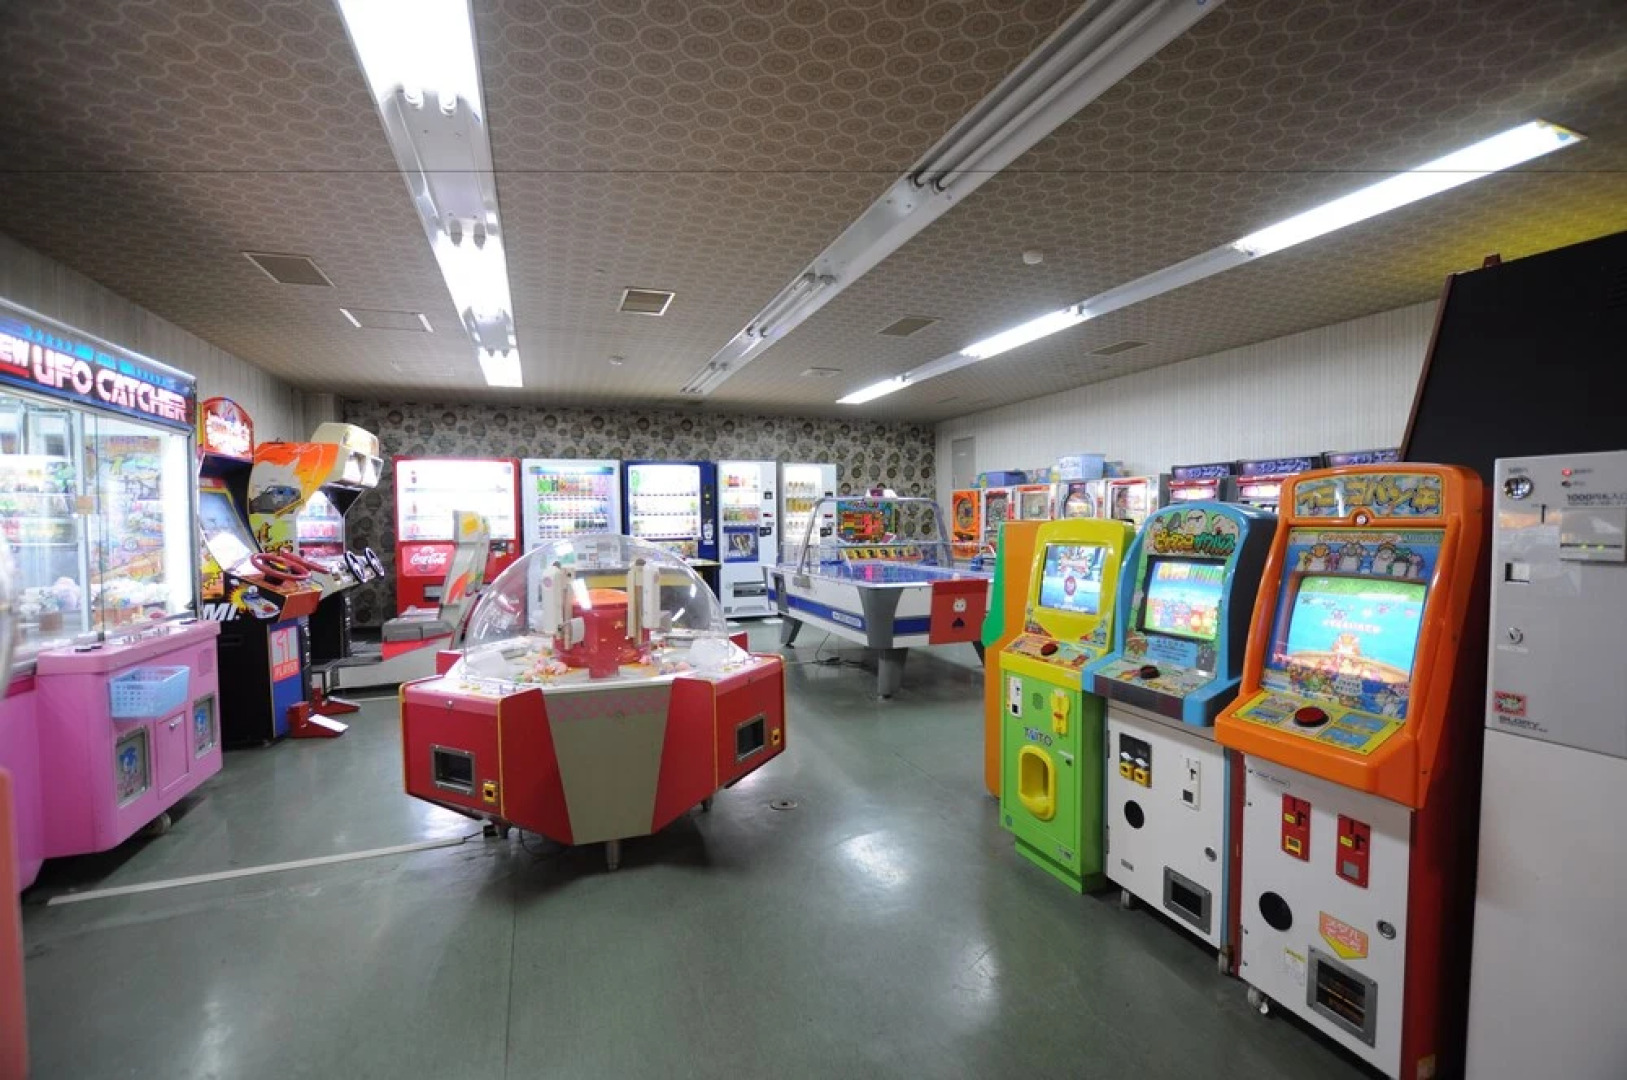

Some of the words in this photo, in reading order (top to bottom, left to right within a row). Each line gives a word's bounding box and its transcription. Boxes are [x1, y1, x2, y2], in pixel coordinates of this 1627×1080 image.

[0, 332, 30, 367] EW
[31, 344, 93, 395] UFO
[95, 368, 187, 423] CATCHER
